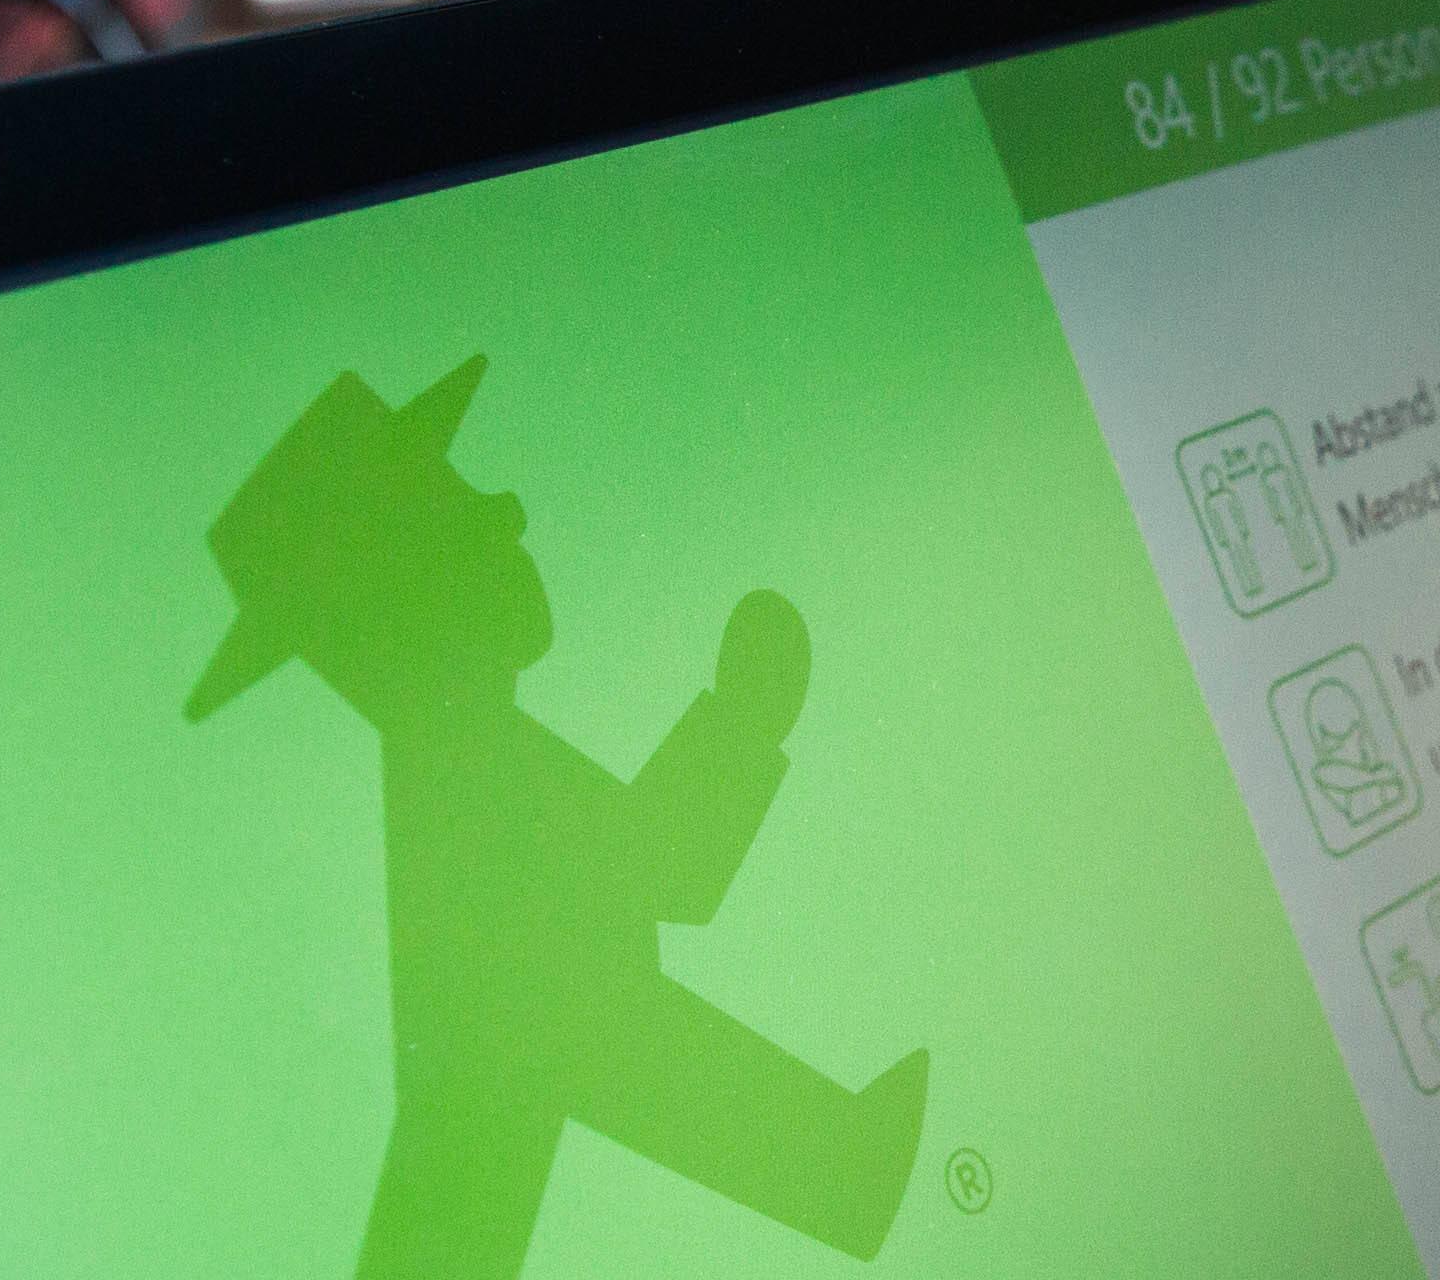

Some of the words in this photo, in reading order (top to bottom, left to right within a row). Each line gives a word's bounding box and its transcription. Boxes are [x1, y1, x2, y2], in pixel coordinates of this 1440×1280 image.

[1124, 73, 1197, 150] 84
[1205, 62, 1224, 141] /
[1230, 46, 1304, 125] 92
[1313, 377, 1436, 467] Abstand
[1393, 653, 1434, 698] In
